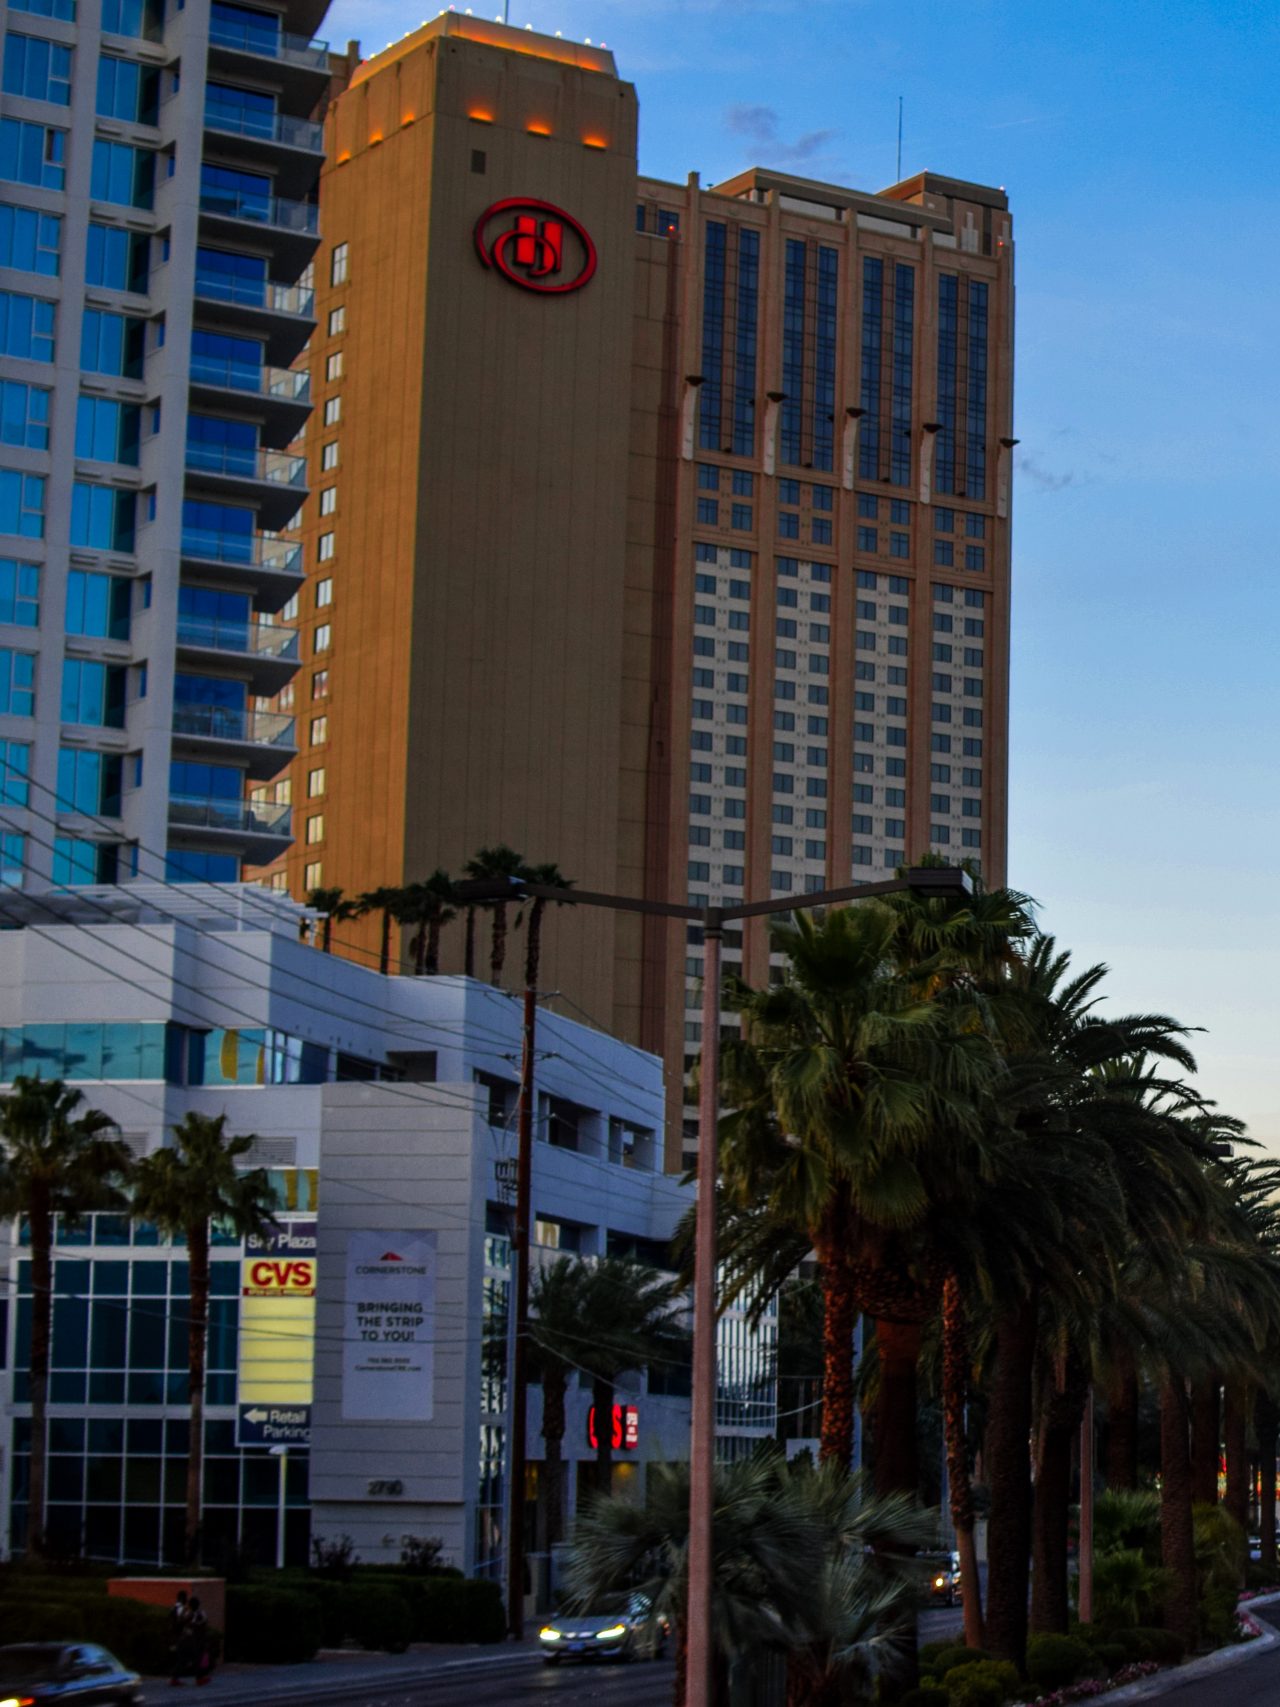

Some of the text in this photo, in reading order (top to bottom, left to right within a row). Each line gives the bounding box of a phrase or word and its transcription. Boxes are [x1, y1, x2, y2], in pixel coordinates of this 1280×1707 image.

[278, 1234, 316, 1248] Plaza
[251, 1261, 311, 1286] CVS
[355, 1266, 427, 1275] CORNERSTONE
[357, 1302, 423, 1313] BRINGING
[357, 1316, 424, 1327] THE STRIP
[361, 1330, 415, 1341] TO YOU!
[270, 1409, 306, 1423] Retail
[588, 1403, 623, 1449] CS
